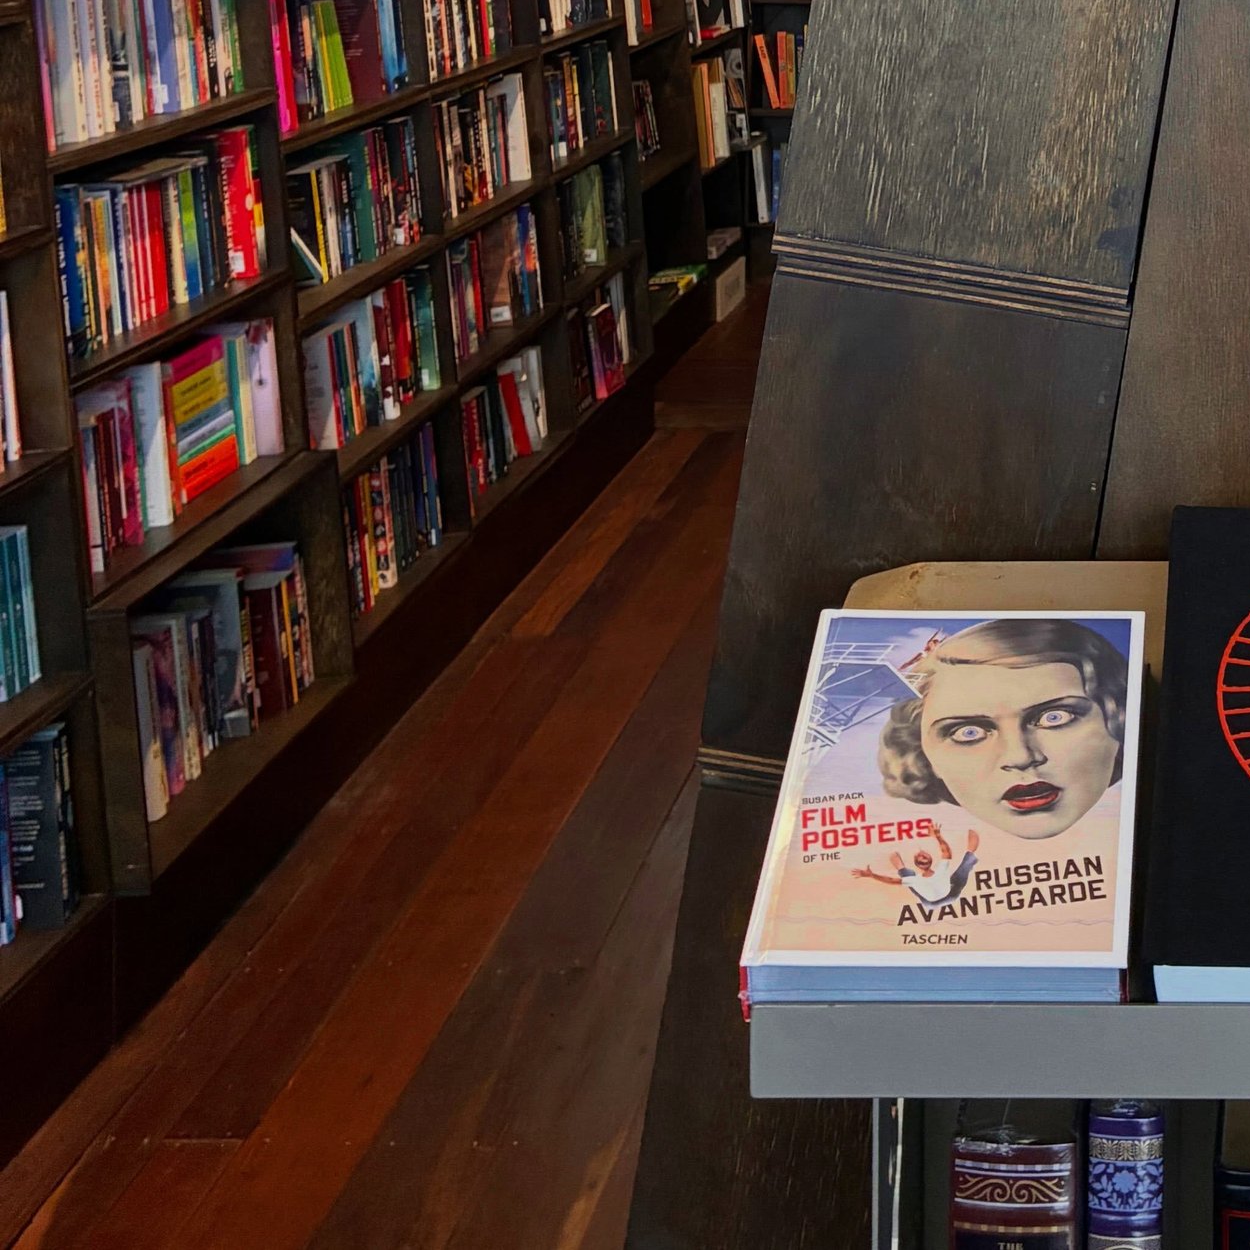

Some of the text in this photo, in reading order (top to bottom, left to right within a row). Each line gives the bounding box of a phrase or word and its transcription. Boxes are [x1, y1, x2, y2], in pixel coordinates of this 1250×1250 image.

[802, 791, 864, 805] SUSAN PACK
[802, 804, 866, 829] FILM
[802, 818, 933, 852] POSTERS
[803, 852, 841, 863] OF THE
[974, 855, 1103, 891] RUSSIAN
[897, 879, 1107, 926] AVANT-GARDE
[902, 934, 968, 945] TASCHEN
